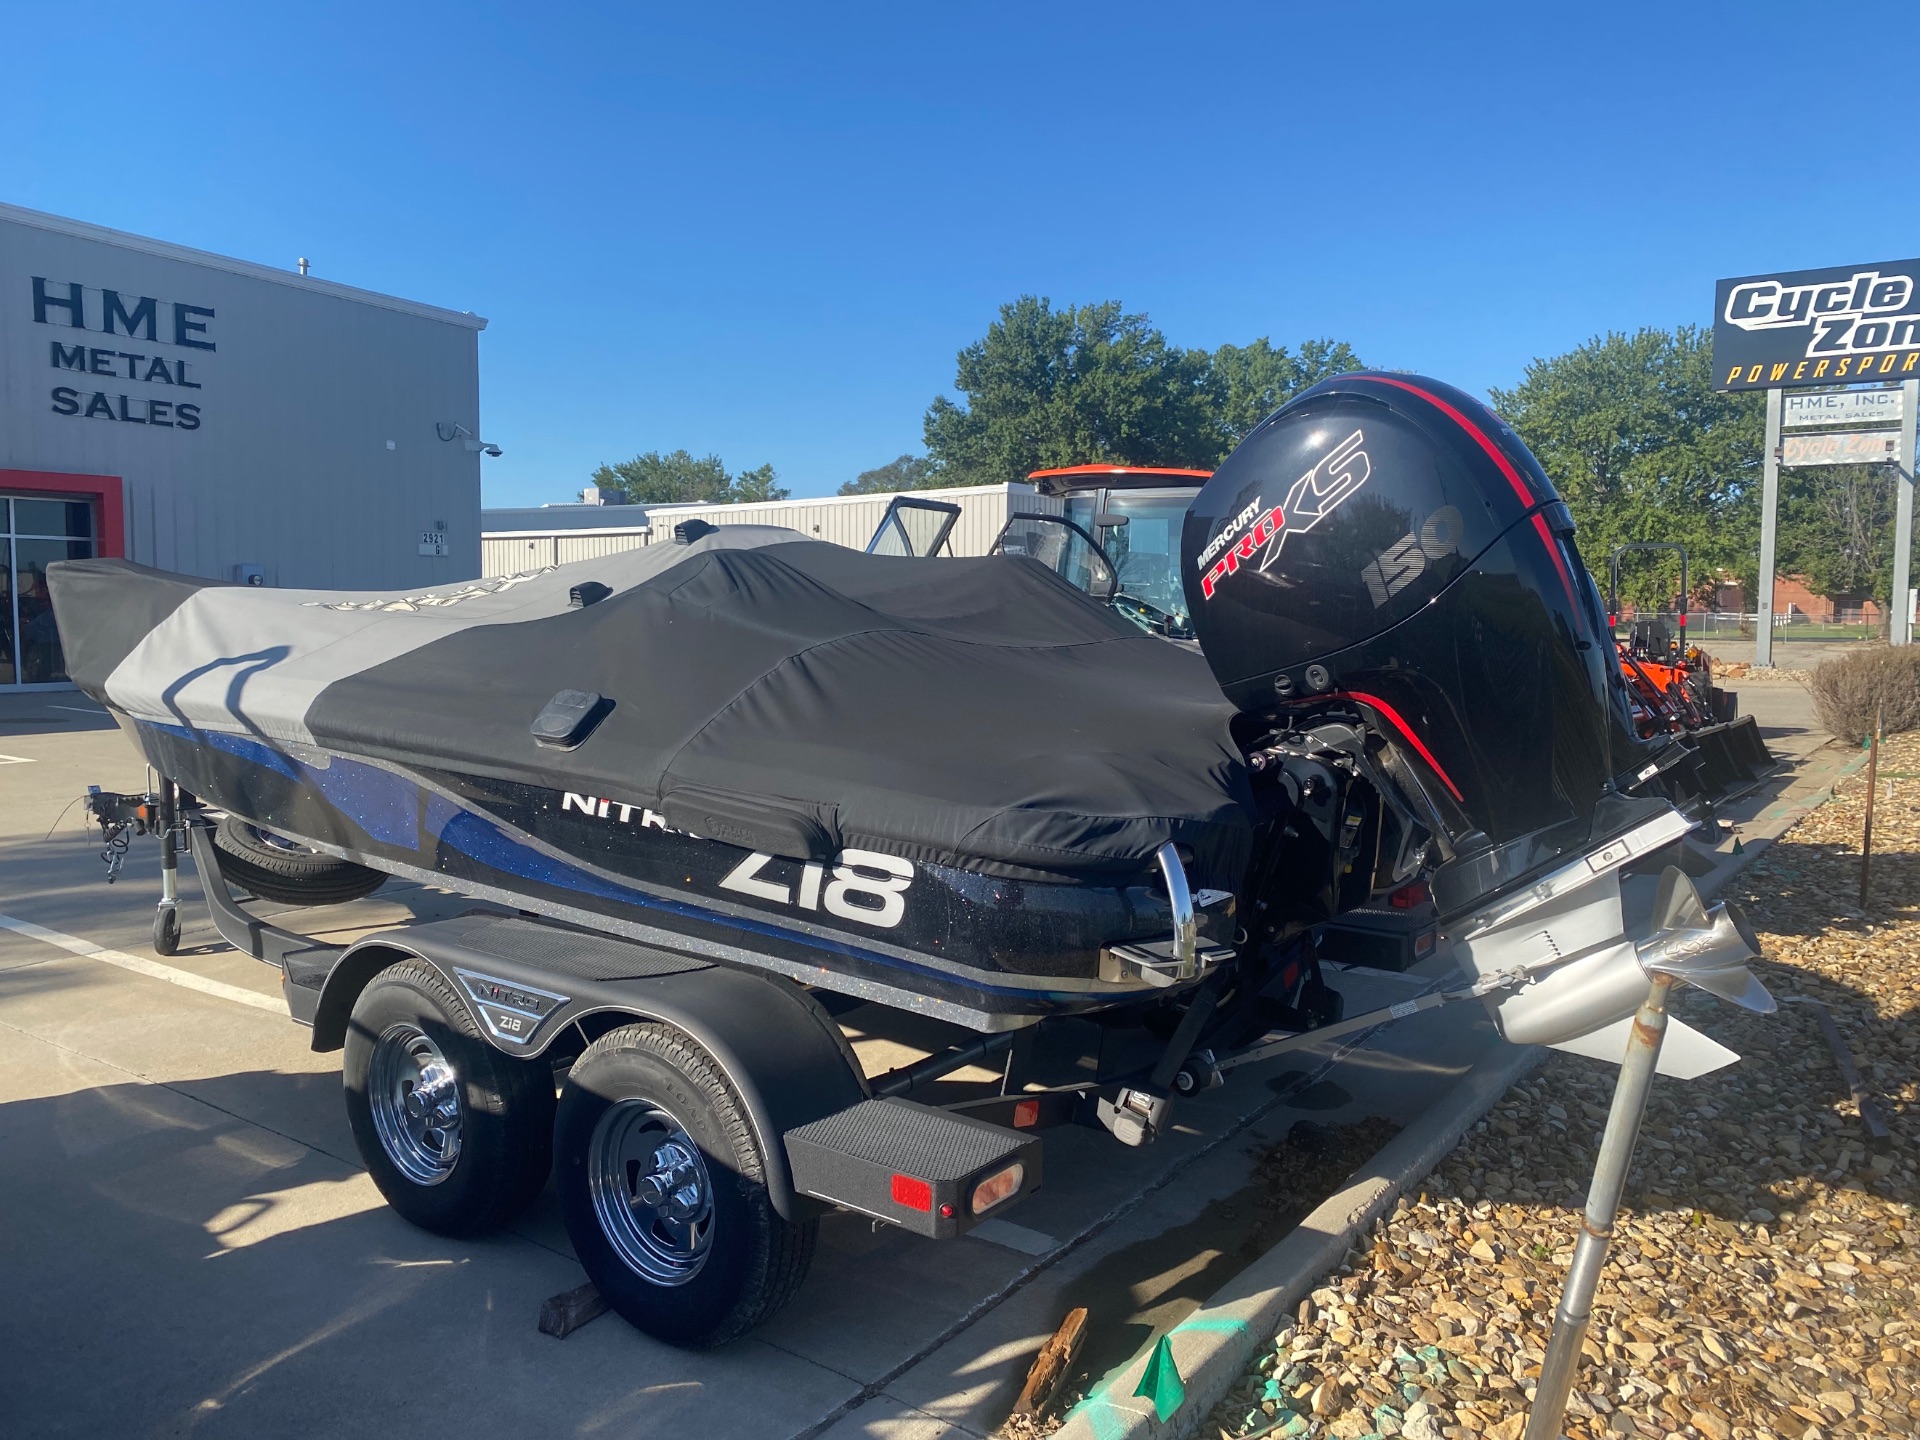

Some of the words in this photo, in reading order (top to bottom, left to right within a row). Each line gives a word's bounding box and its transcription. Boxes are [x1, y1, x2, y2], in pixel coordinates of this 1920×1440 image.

[31, 276, 216, 353] HME
[1725, 271, 1914, 331] Cycle
[52, 341, 201, 389] METAL
[52, 386, 201, 430] SALES
[1790, 396, 1845, 409] HME,
[423, 533, 444, 544] 2921
[1197, 495, 1262, 570] MERCURY
[1361, 504, 1464, 609] 150
[499, 1015, 522, 1032] Z18
